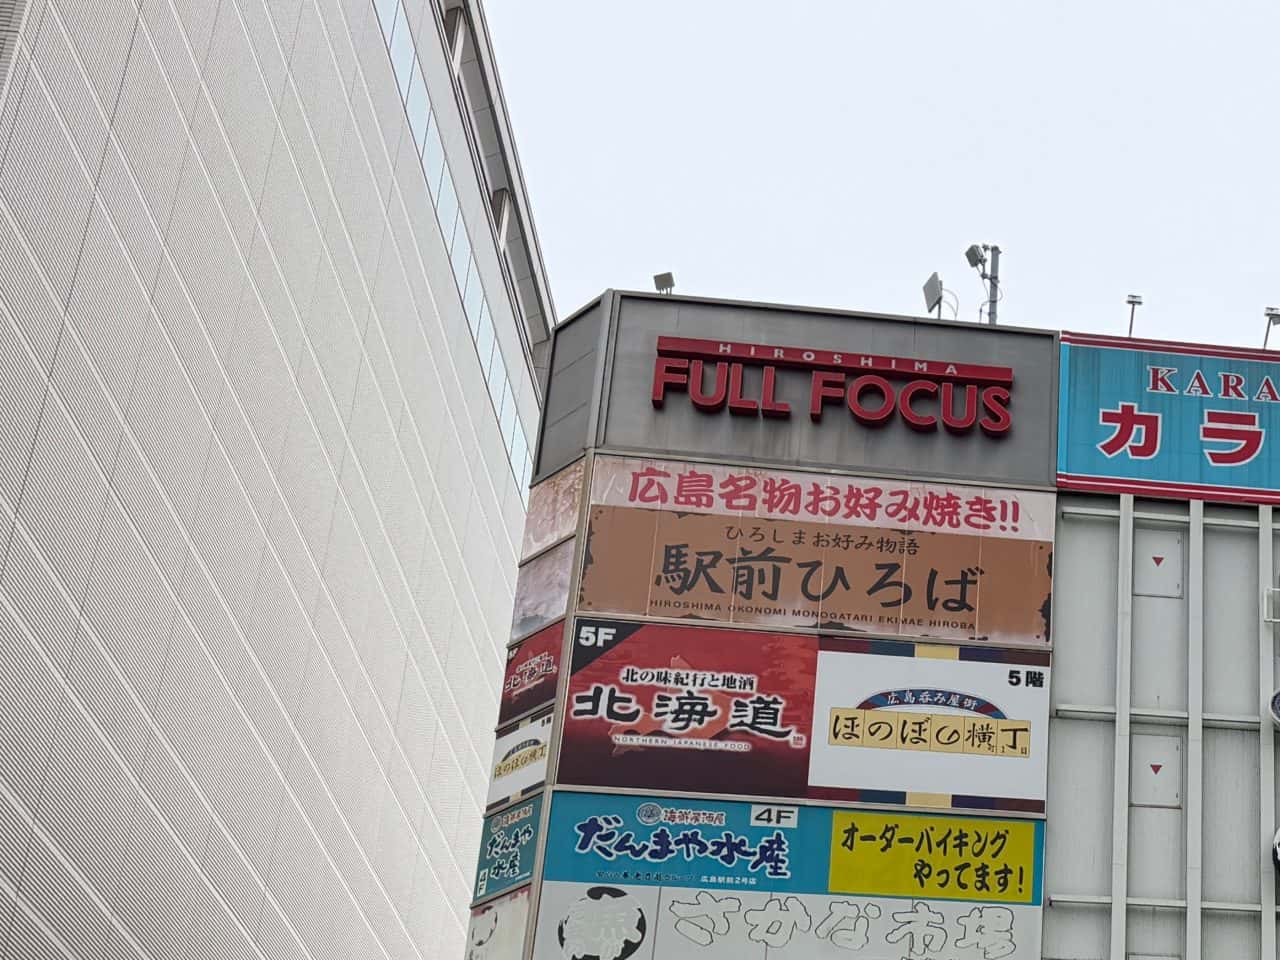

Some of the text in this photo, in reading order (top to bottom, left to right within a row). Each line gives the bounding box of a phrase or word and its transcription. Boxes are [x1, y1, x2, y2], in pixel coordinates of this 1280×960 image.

[718, 343, 959, 376] HIROSHIMA
[651, 356, 1014, 437] FULL FOCUS
[628, 466, 1020, 533] 広島名物お好み焼き!!
[654, 541, 985, 613] 駅前ひろば
[650, 599, 976, 632] HIROSHIMA OKONOMI MONOGATARI EKIMAE HIROBA
[578, 626, 617, 648] 5F
[622, 668, 755, 691] 北の味紀行と地酒
[1008, 669, 1044, 688] 5階
[573, 686, 793, 739] 北海道
[614, 735, 668, 745] NORTHERN
[832, 713, 1029, 750] ほのぼの横丁
[754, 808, 795, 825] 4F
[576, 816, 791, 878] だんまや水産
[840, 821, 1009, 860] オーダーバイキング
[912, 858, 1026, 894] やってます!
[669, 890, 1017, 960] さかな市場
